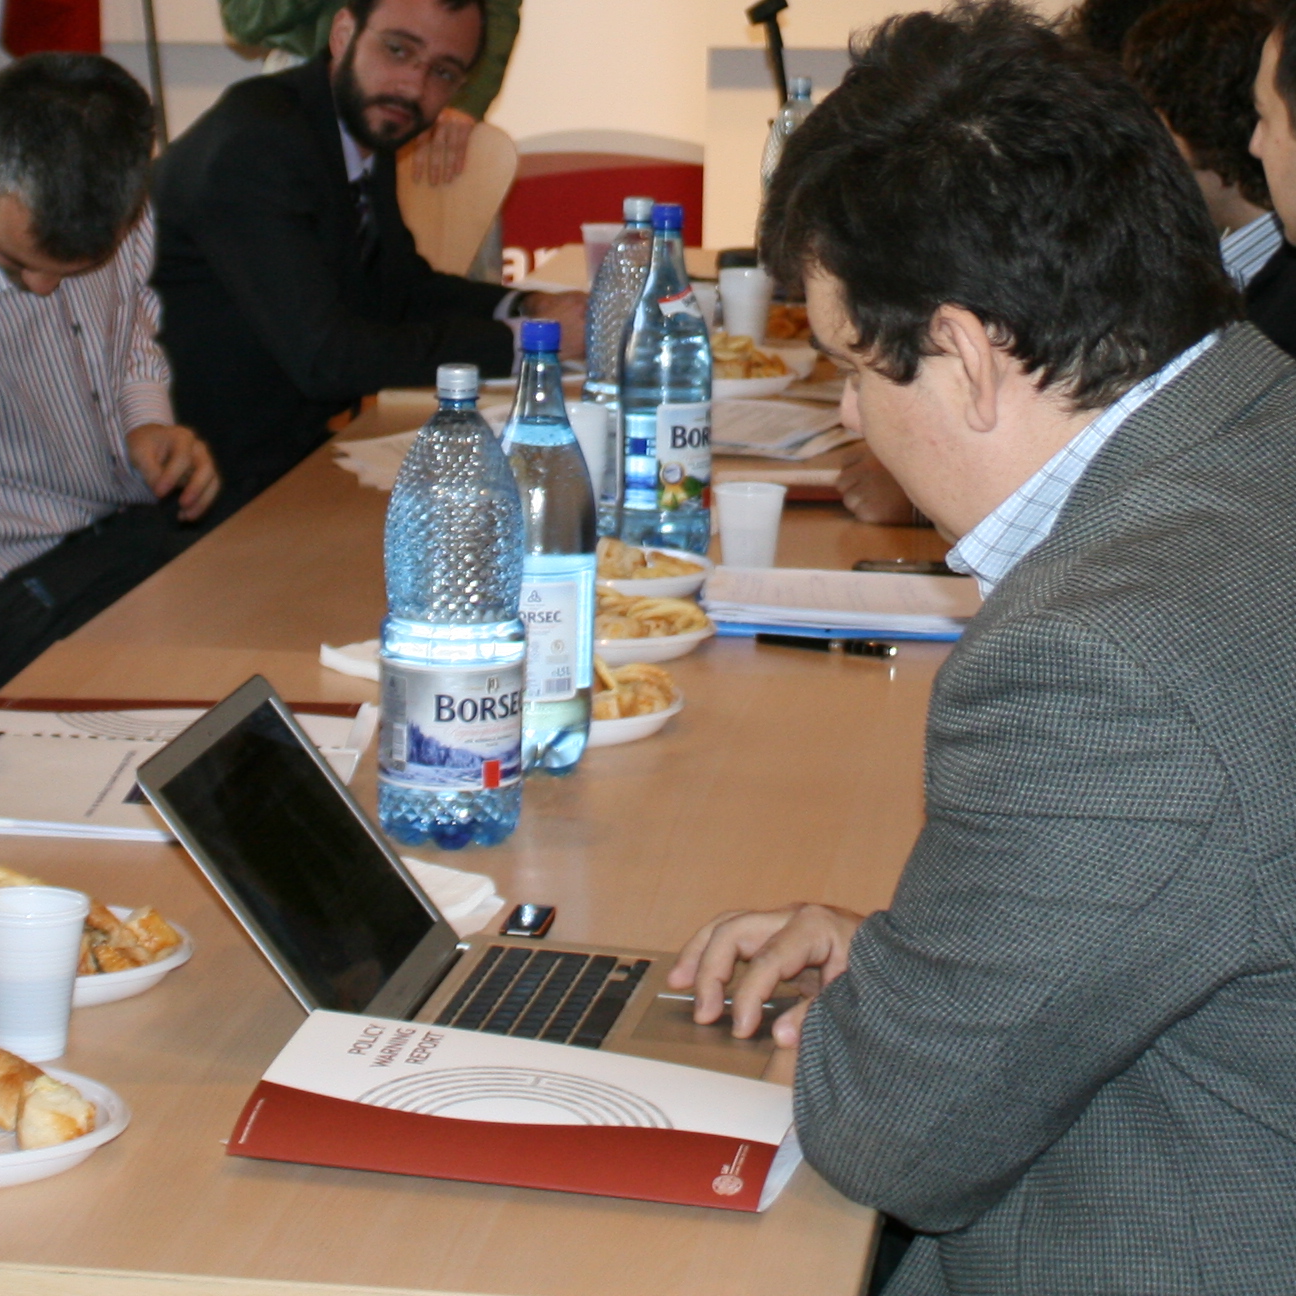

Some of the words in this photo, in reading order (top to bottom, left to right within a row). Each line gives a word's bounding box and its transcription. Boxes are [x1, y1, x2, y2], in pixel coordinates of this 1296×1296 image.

[670, 425, 711, 449] BOR
[519, 609, 562, 623] ORSEC
[433, 688, 525, 723] BORSE
[347, 1023, 387, 1055] POLICY
[369, 1027, 417, 1067] WARNING
[404, 1030, 445, 1065] REPORT
